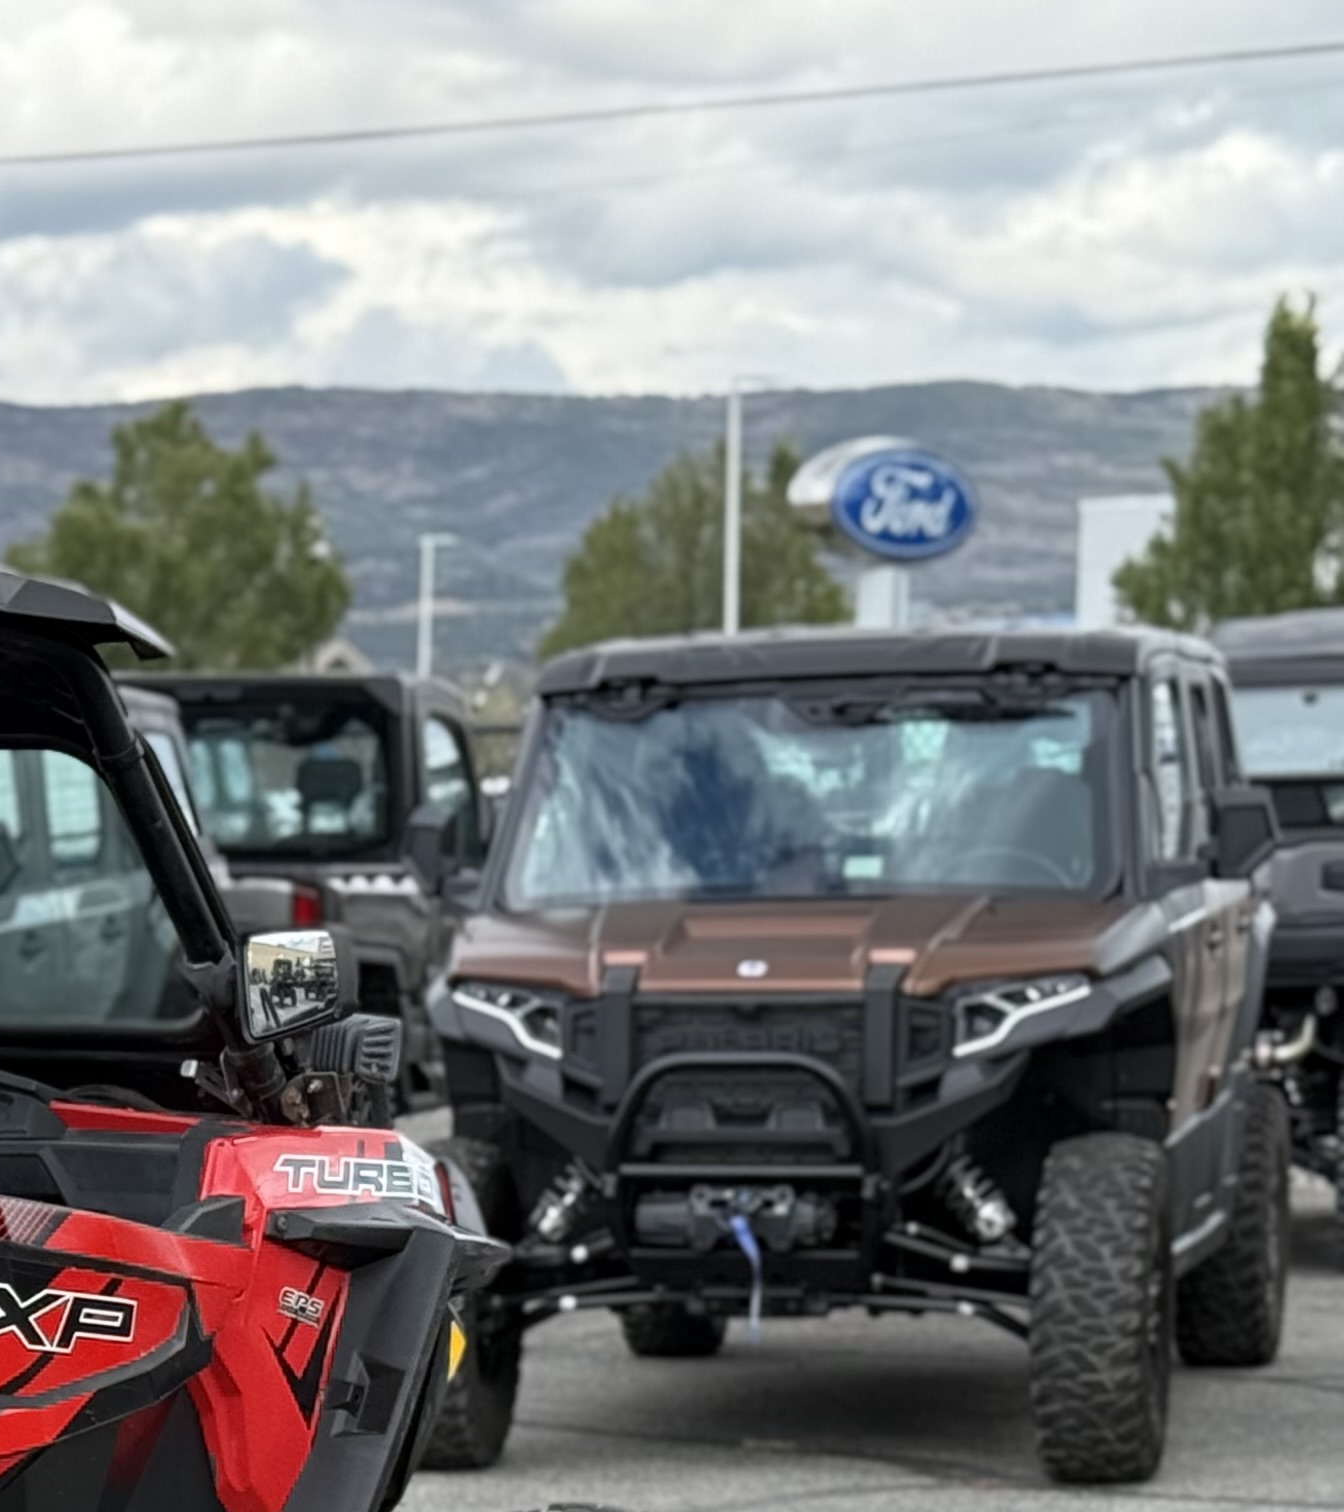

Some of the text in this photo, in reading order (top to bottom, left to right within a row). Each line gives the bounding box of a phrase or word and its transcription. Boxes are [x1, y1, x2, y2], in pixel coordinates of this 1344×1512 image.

[860, 464, 958, 538] Ford
[273, 1154, 436, 1206] TURBO
[279, 1287, 324, 1318] EPS
